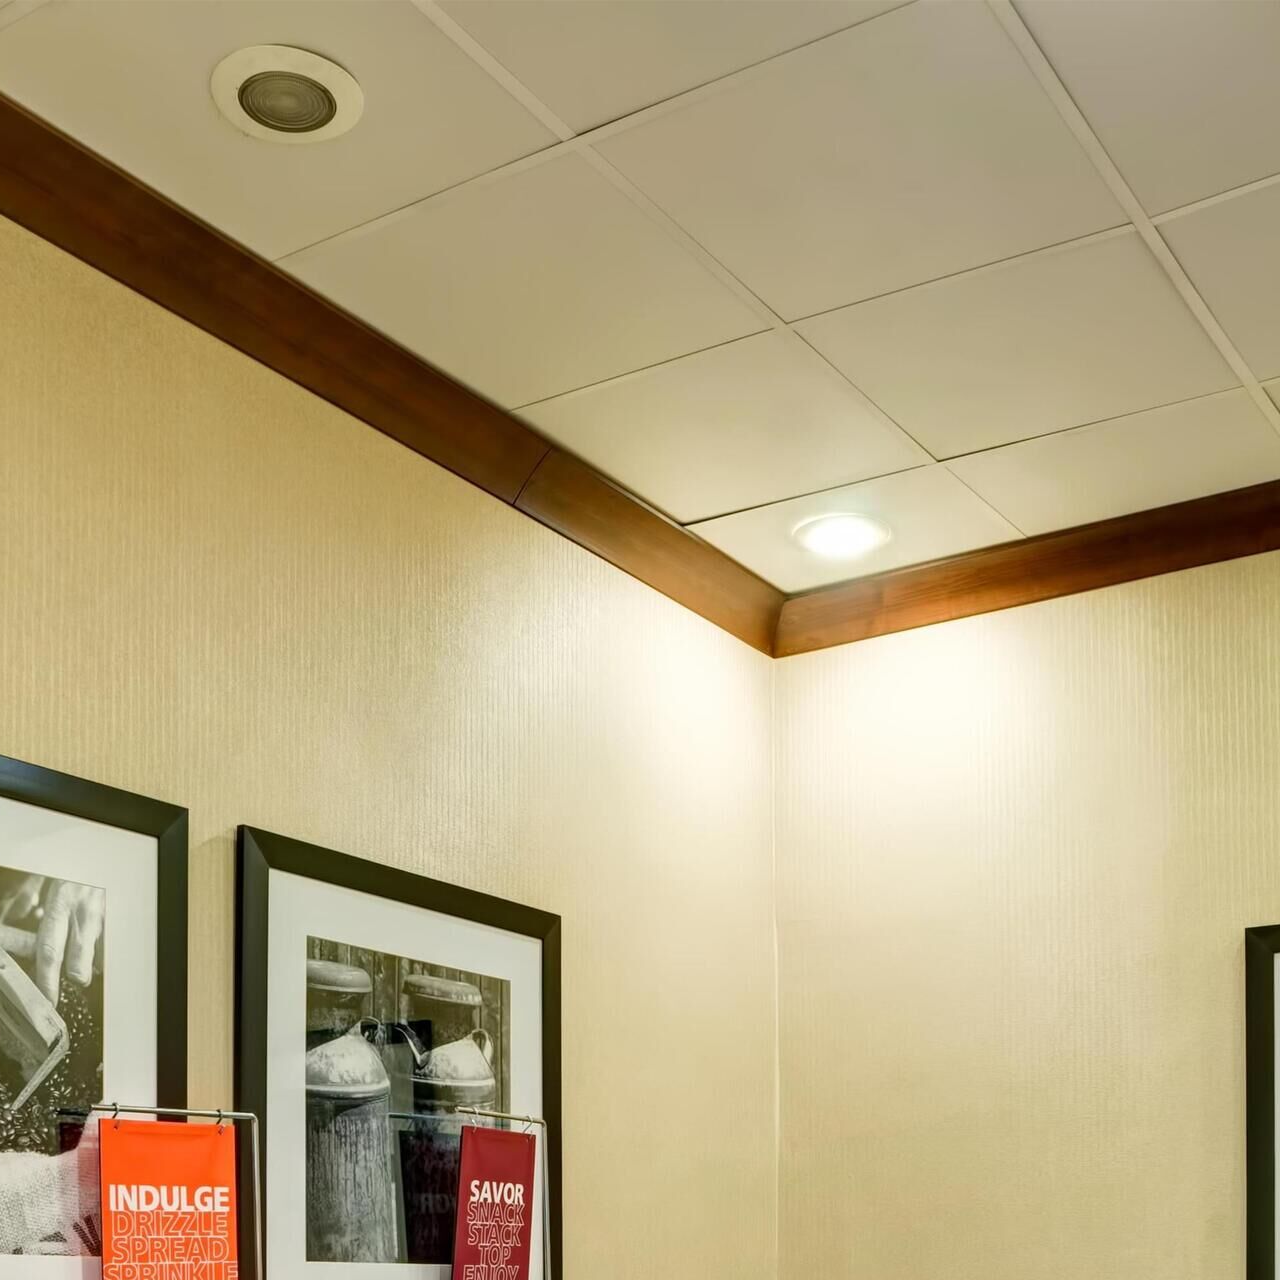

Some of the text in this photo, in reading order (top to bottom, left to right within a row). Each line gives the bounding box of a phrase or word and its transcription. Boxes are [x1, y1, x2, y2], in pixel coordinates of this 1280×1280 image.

[109, 1184, 231, 1212] INDULGE
[470, 1179, 525, 1206] SAVOR
[111, 1209, 229, 1238] DRIZZLE
[466, 1200, 526, 1226] SNACK
[467, 1221, 521, 1247] STACK
[111, 1235, 230, 1265] SPREAD
[478, 1242, 512, 1268] TOP
